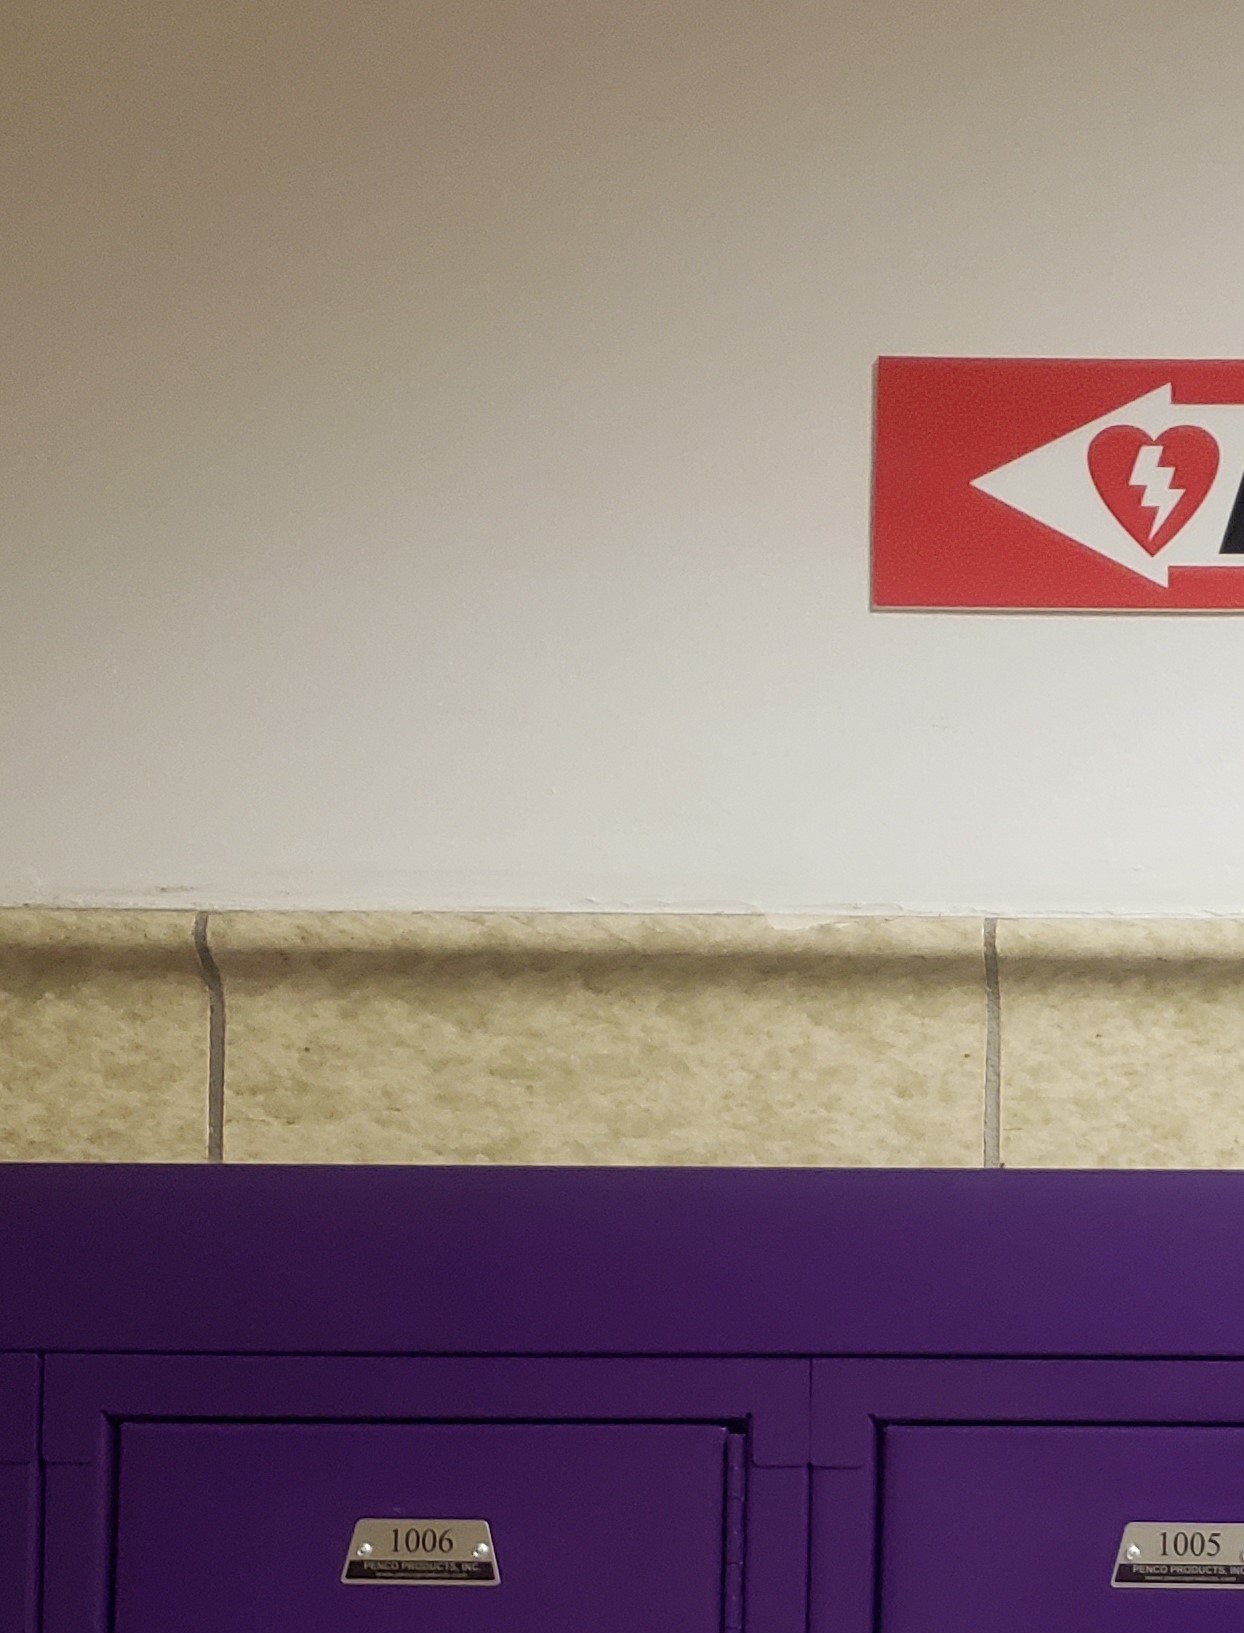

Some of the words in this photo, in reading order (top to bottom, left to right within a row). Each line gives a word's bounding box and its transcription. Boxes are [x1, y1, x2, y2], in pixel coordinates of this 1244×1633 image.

[391, 1527, 454, 1553] 1006
[1159, 1531, 1222, 1557] 1005
[363, 1561, 399, 1570] PENCO
[1132, 1565, 1168, 1574] PENCO
